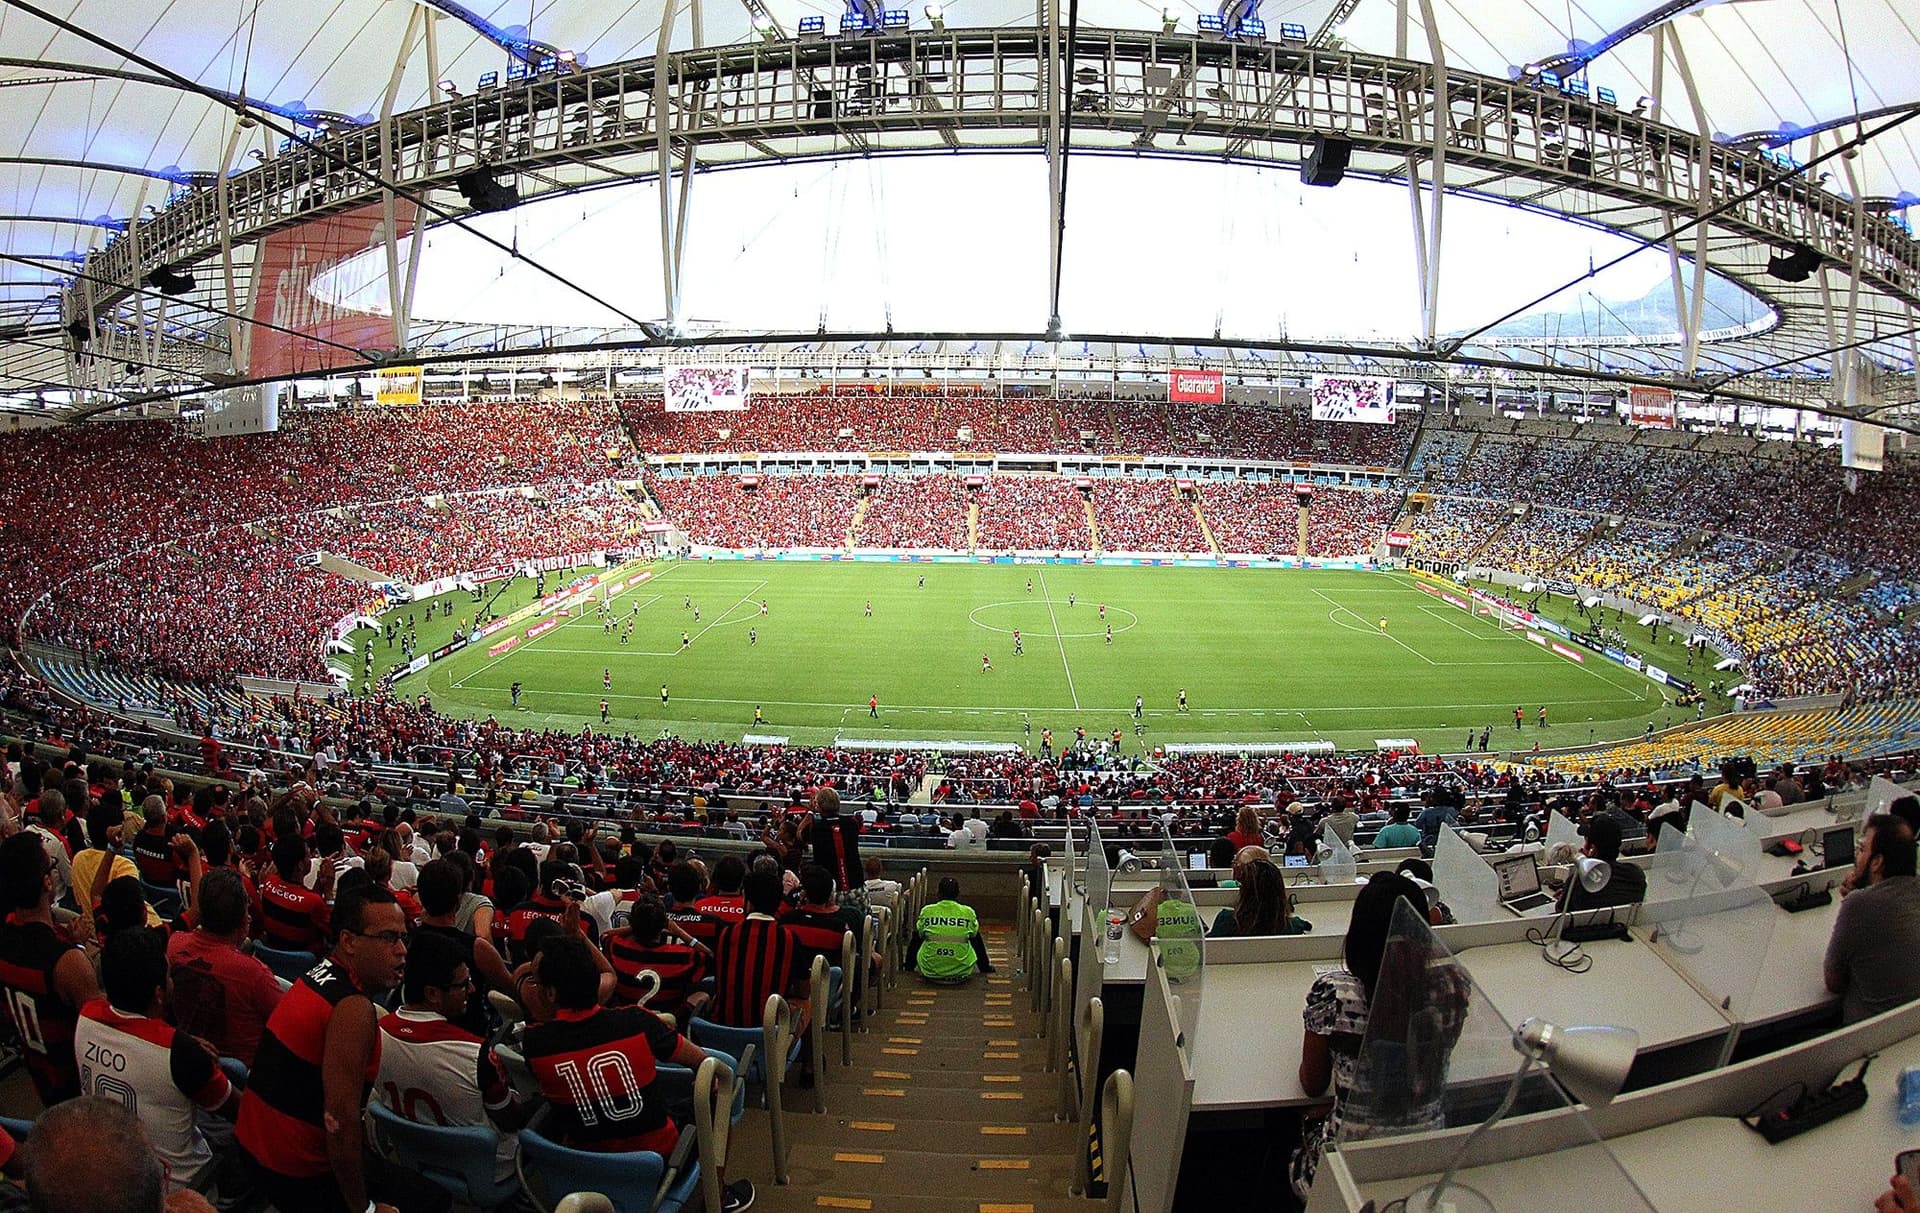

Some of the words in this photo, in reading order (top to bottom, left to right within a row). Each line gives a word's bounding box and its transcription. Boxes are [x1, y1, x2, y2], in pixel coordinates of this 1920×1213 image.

[1177, 373, 1216, 394] Guaravita
[701, 905, 745, 914] PEUGEO
[924, 917, 970, 928] SUNSET
[937, 948, 955, 956] 693
[84, 1041, 126, 1073] ZICO
[555, 1050, 644, 1127] 10
